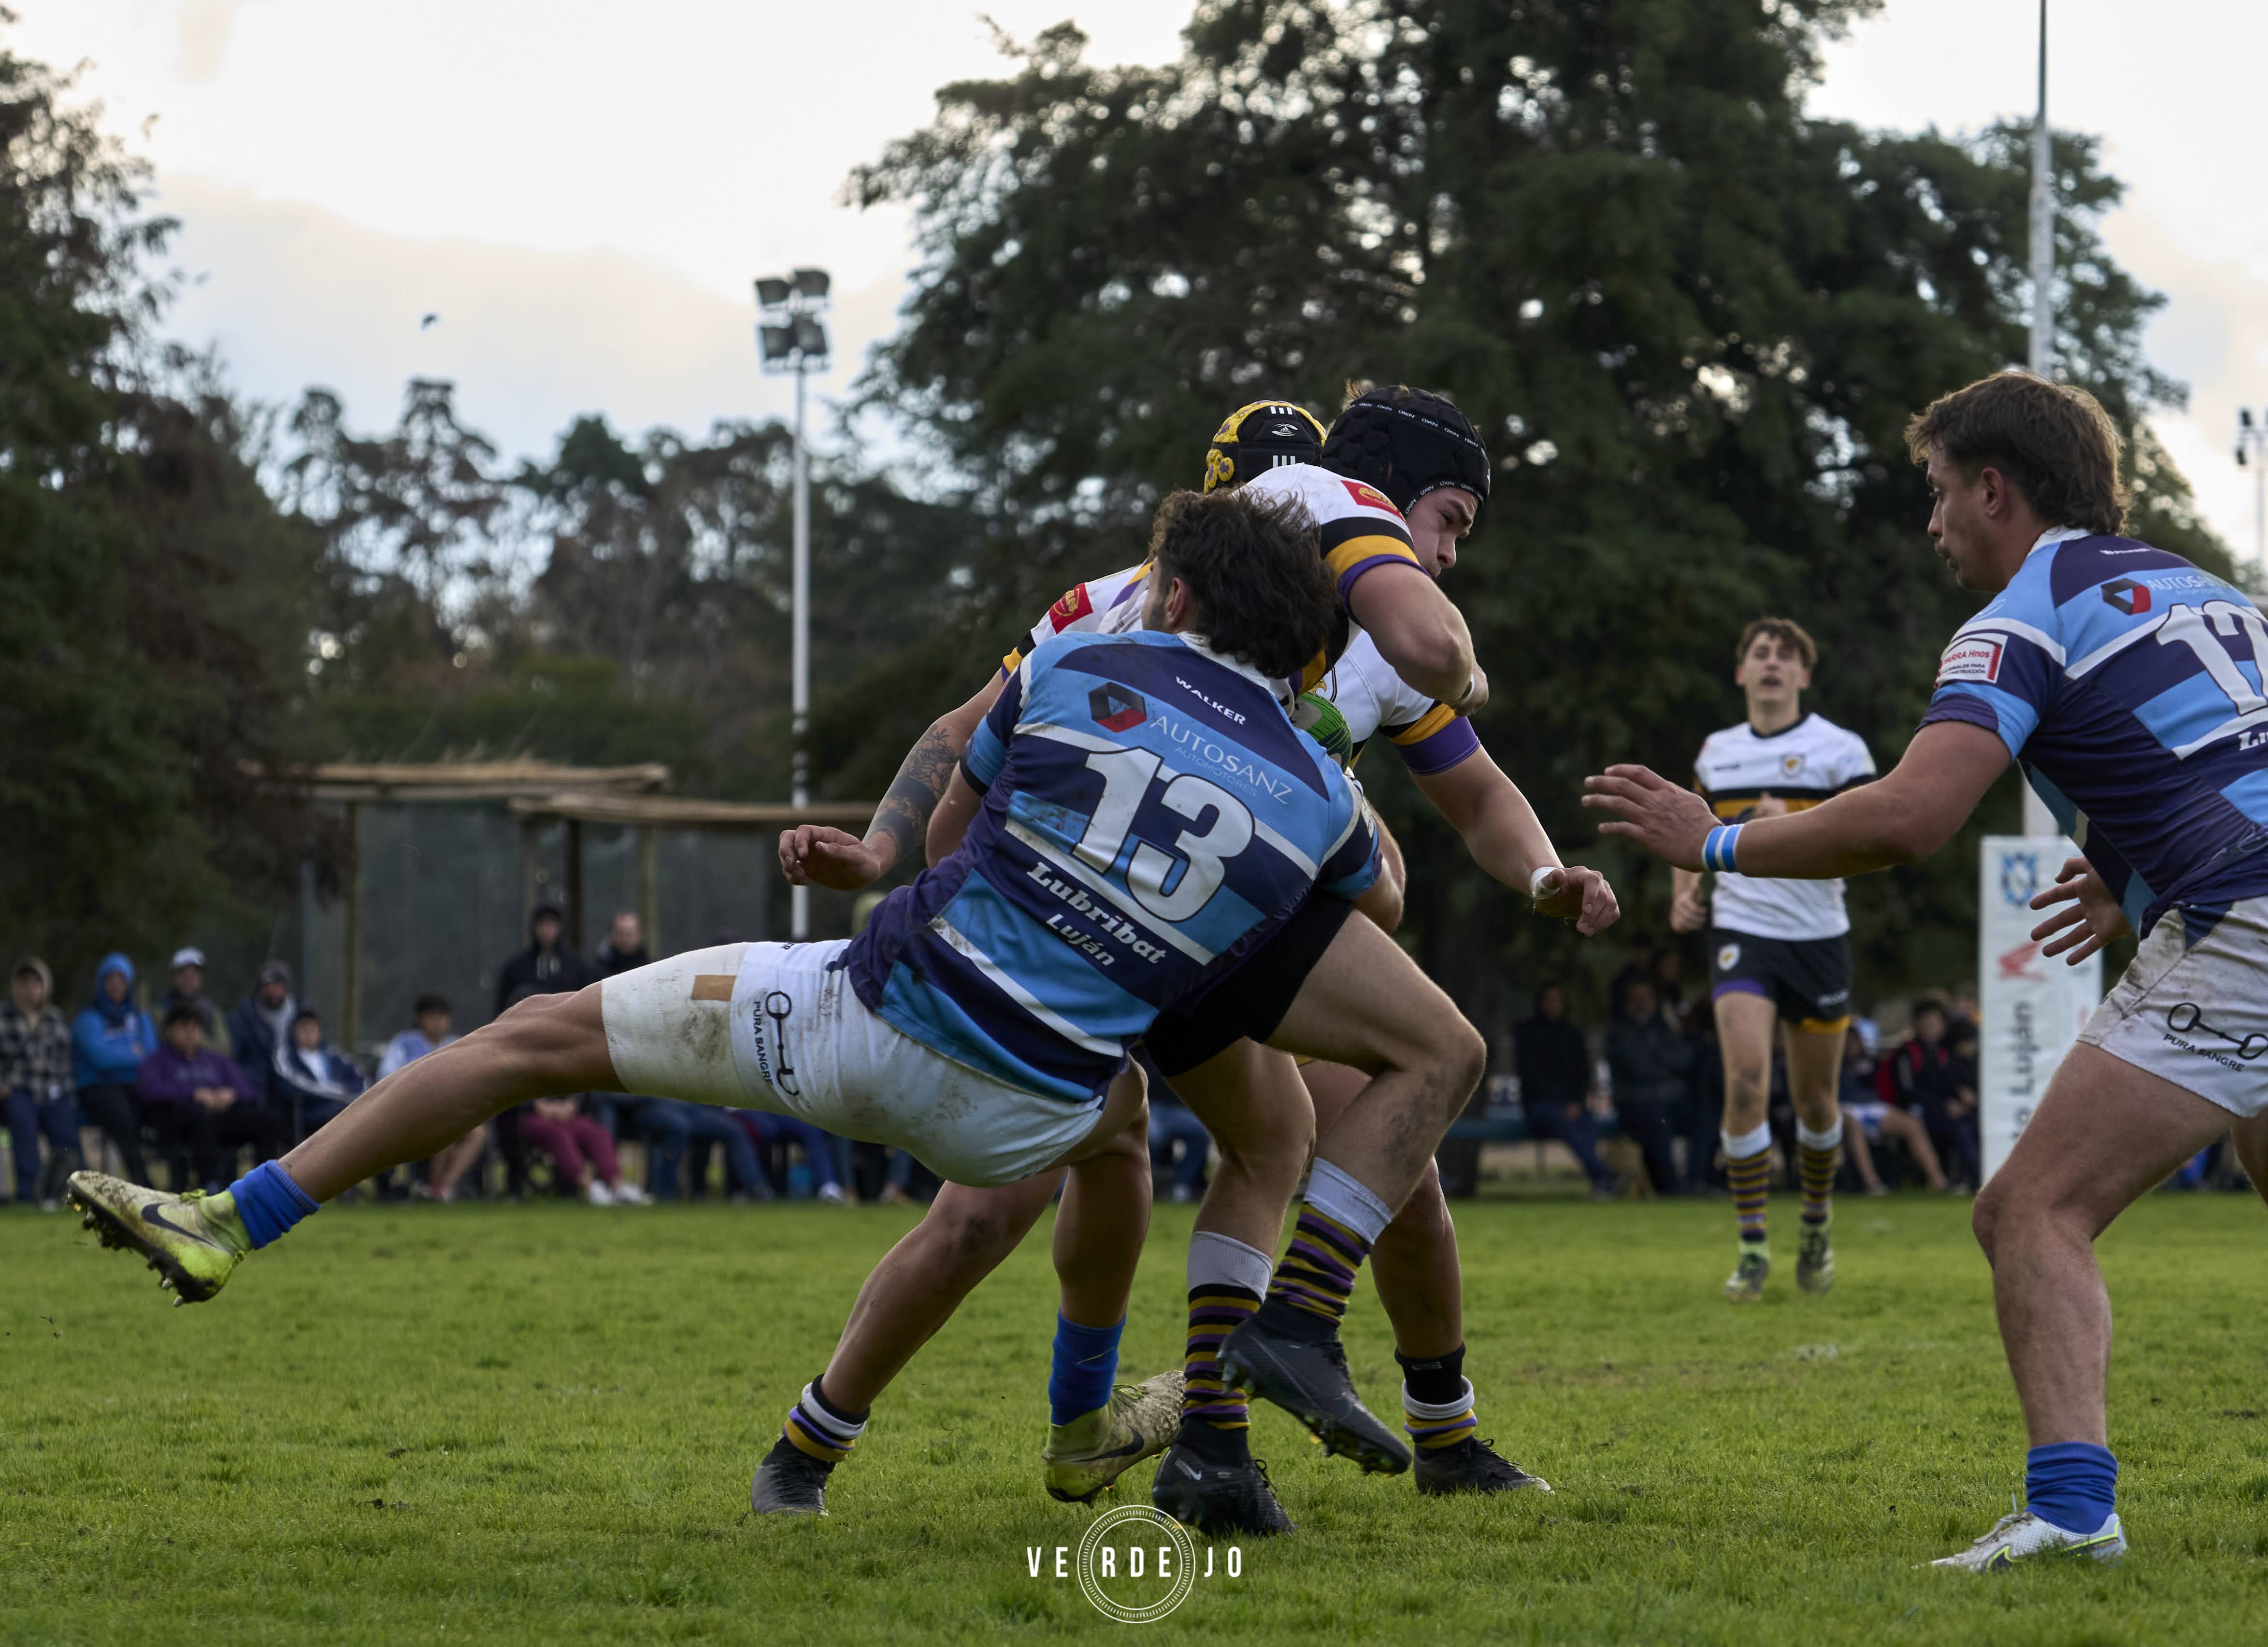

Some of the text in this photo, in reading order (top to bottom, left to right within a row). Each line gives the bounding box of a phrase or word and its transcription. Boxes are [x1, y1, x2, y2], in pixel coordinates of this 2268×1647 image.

[1968, 649, 1990, 659] Hnos
[1176, 676, 1246, 725] WALKER
[1149, 716, 1293, 805] AUTOSANZ
[1175, 746, 1257, 797] AUTOMOTORES
[1070, 745, 1256, 924] 13
[1026, 861, 1167, 964] Lubribat
[1046, 913, 1115, 966] Luján
[753, 1001, 762, 1035] PURA
[2164, 1033, 2246, 1072] PURA SANGRE
